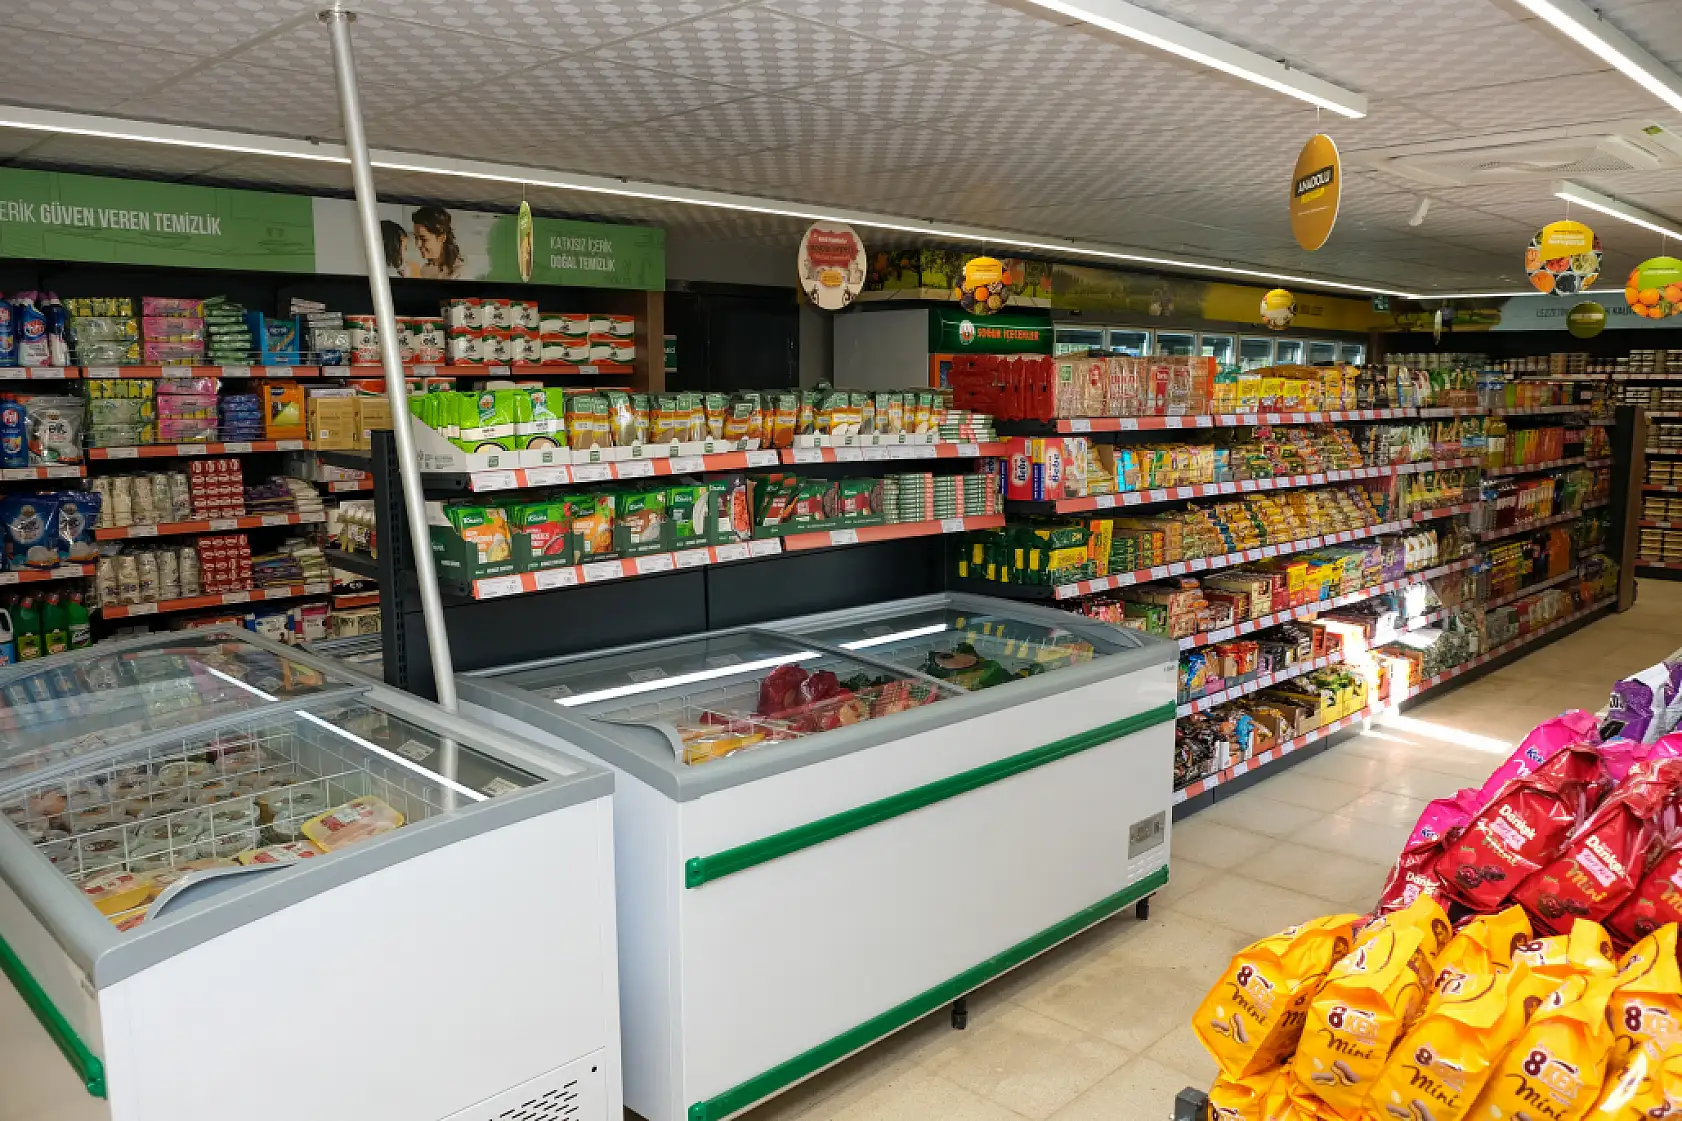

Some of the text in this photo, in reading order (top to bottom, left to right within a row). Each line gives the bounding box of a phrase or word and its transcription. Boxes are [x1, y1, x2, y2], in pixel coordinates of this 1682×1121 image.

[40, 202, 95, 227] GÜVEN
[98, 208, 150, 231] VEREN
[154, 212, 222, 236] TEMİZLİK
[1317, 1027, 1374, 1060] mini
[1401, 1064, 1461, 1108] mini
